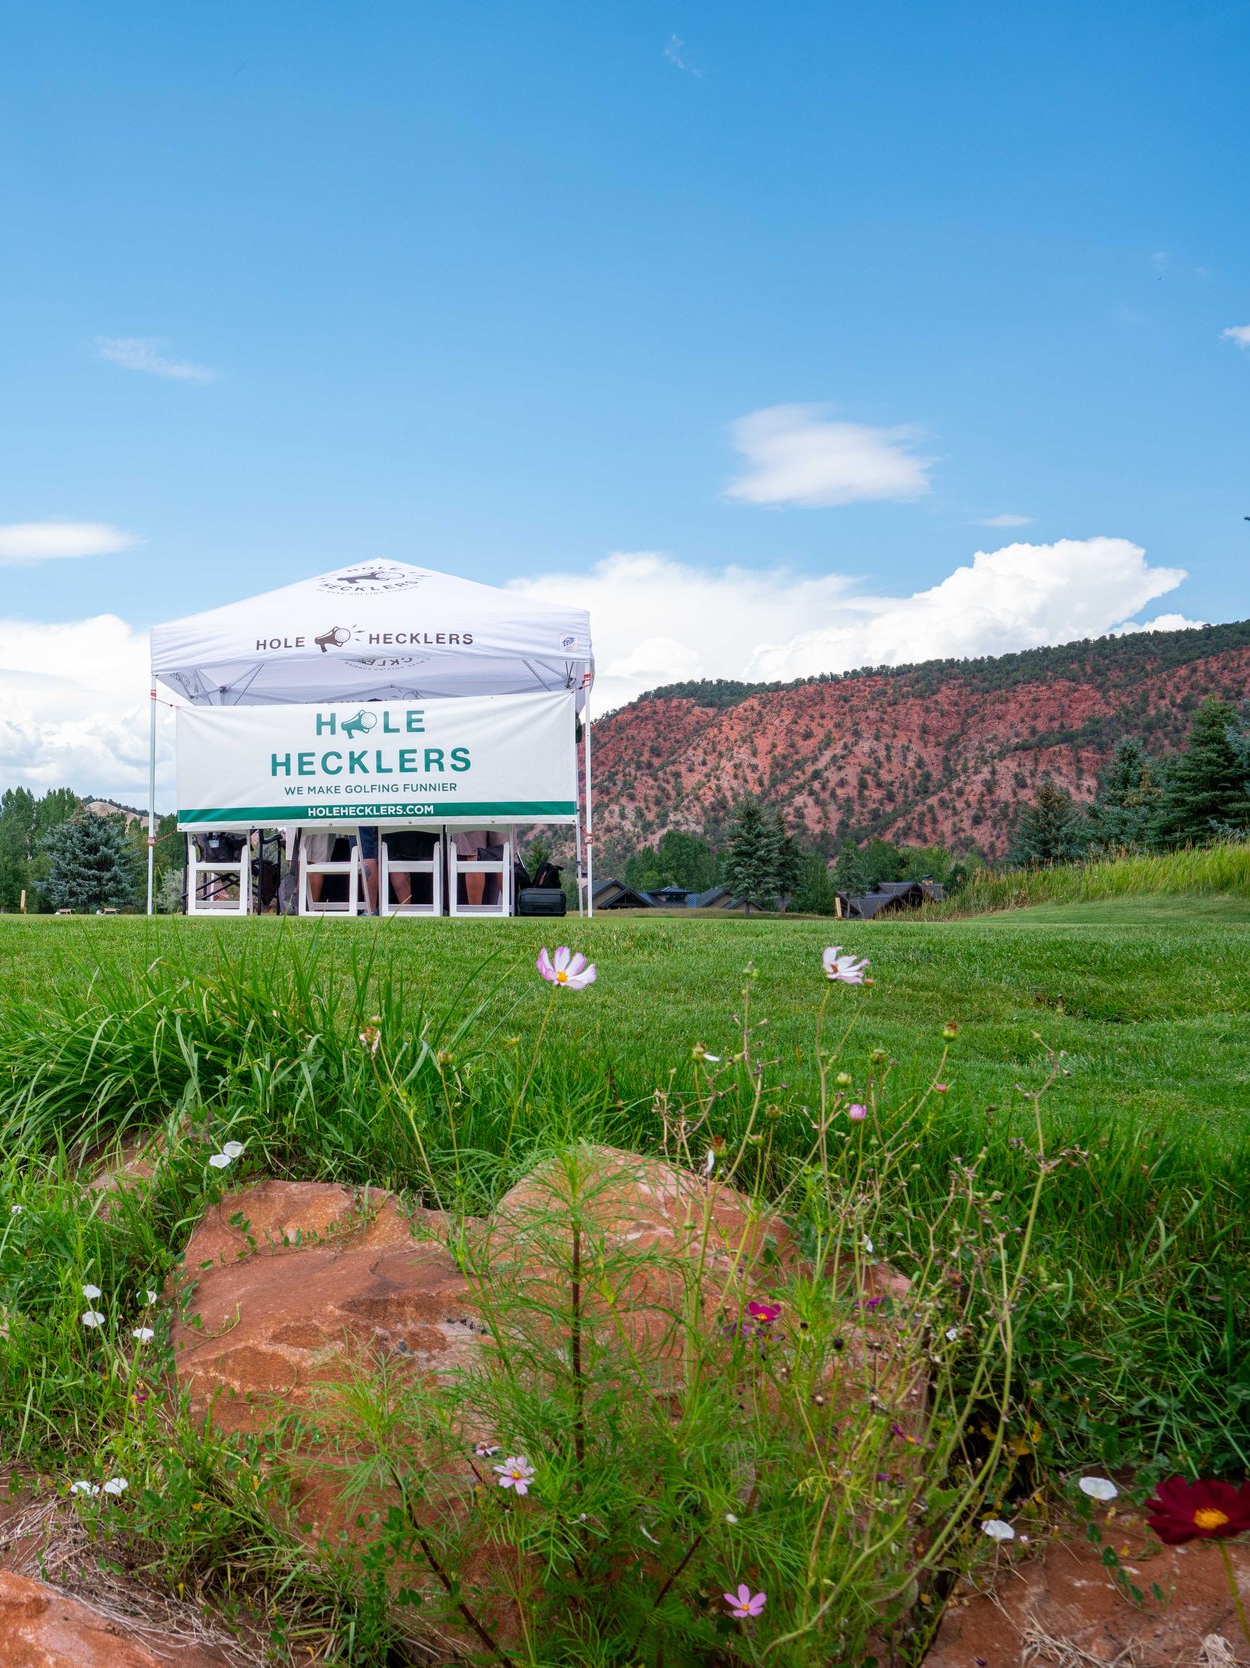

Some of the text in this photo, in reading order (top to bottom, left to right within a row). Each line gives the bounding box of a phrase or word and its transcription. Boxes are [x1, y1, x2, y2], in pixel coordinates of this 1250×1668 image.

[256, 633, 474, 651] HOLE HECKLERS
[271, 747, 472, 777] HECKLERS
[284, 782, 458, 796] WE MAKE GOLFING FUNNIER
[307, 804, 435, 818] HOLEHECKLERS.COM
